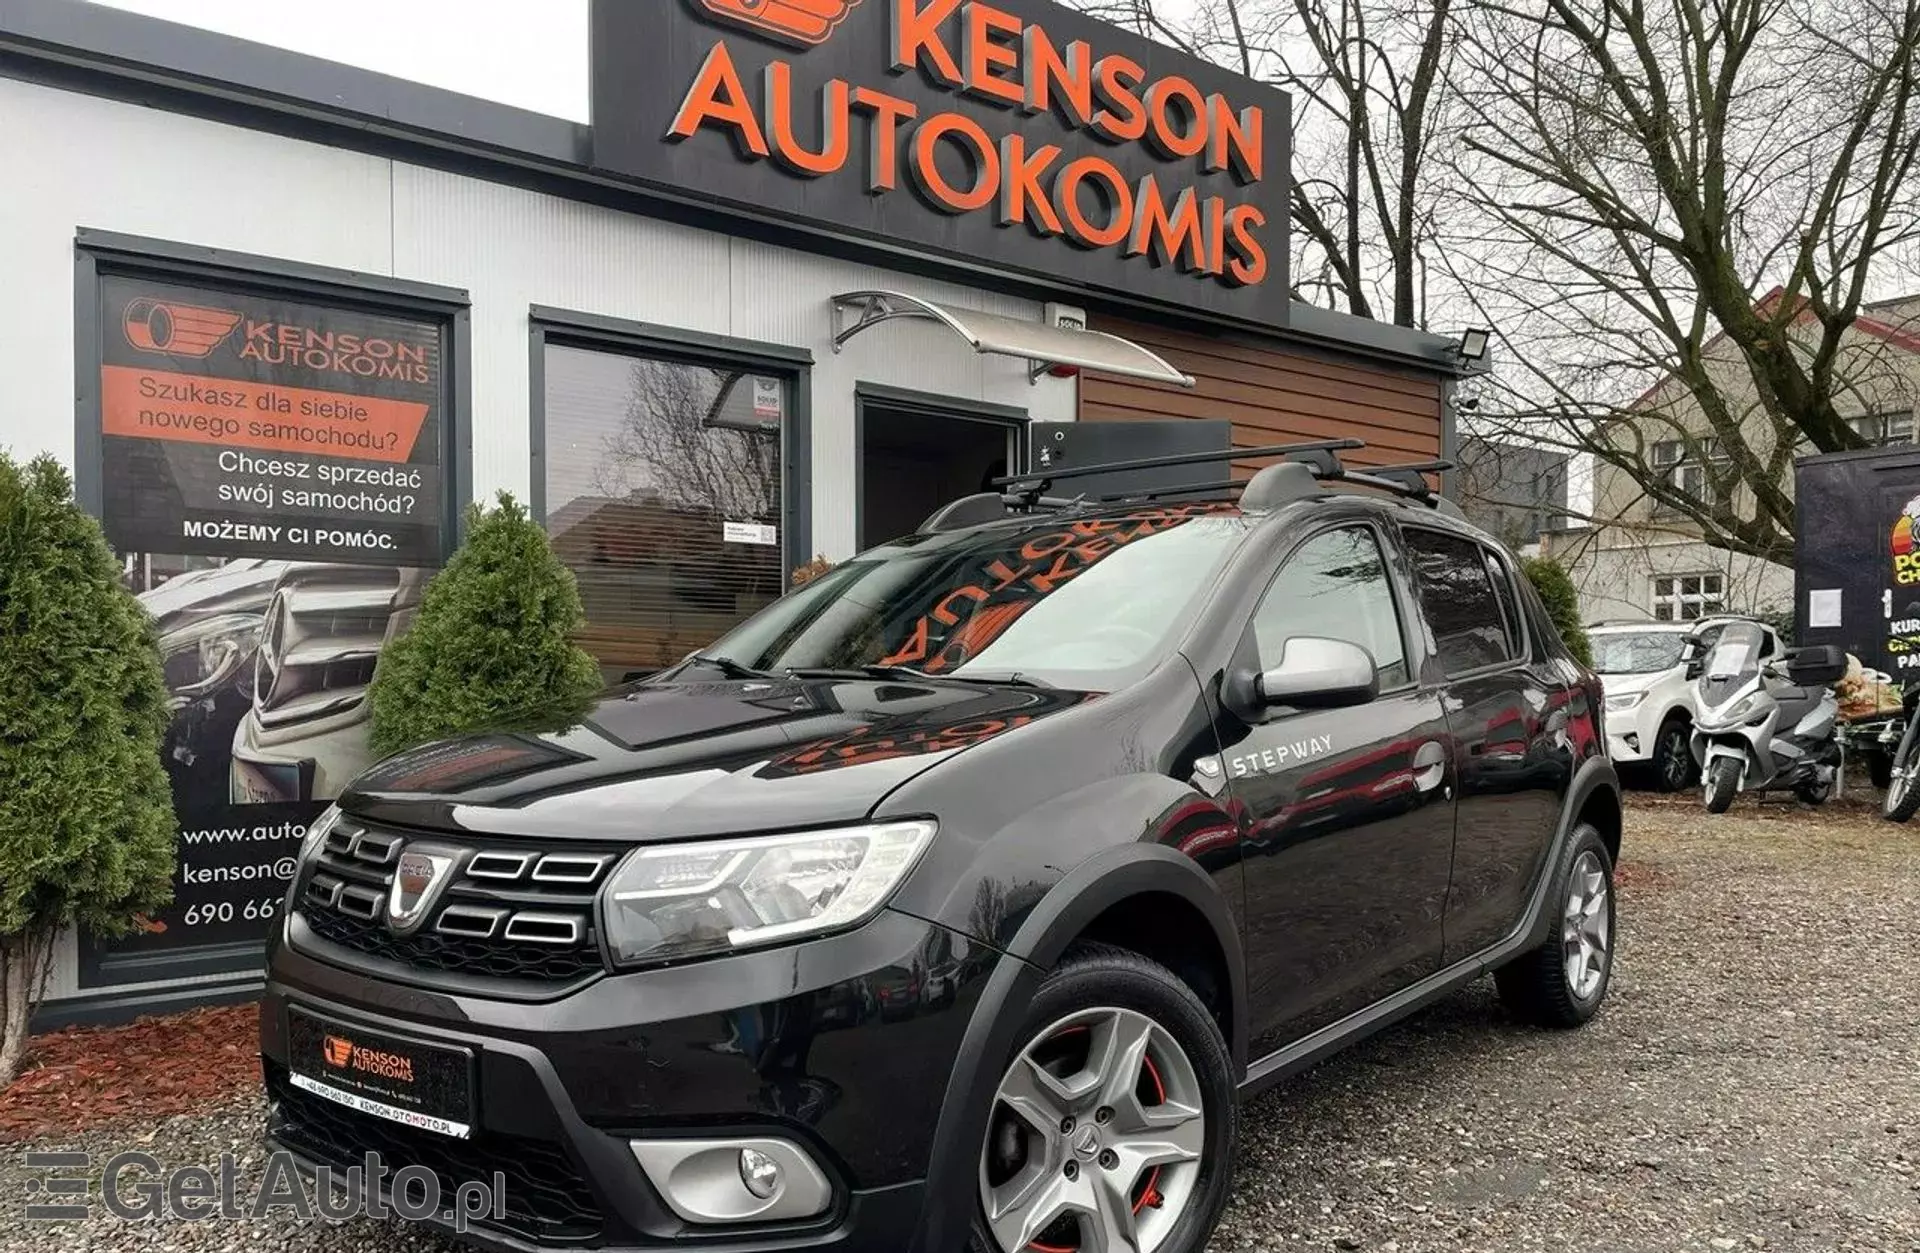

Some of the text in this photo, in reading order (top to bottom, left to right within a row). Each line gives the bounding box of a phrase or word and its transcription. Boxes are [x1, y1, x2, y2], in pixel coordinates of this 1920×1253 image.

[891, 0, 1262, 182] KENSON
[667, 40, 1267, 285] AUTOKOMIS
[244, 320, 425, 363] KENSON
[239, 341, 429, 384] AUTOKOMIS
[138, 377, 369, 422] Szukasz dla siebie
[138, 409, 399, 450] nowego samochodu?
[218, 451, 422, 490] Chcesz sprzedać
[218, 483, 416, 515] swój samochód?
[182, 519, 398, 550] MOŻEMY CI POMÓC.
[1232, 733, 1332, 777] STEPWAY
[182, 822, 306, 845] www.auto
[184, 857, 299, 884] kenson@
[184, 897, 285, 926] 690 66
[352, 1046, 411, 1070] KENSON
[352, 1059, 414, 1082] AUTOKOMIS
